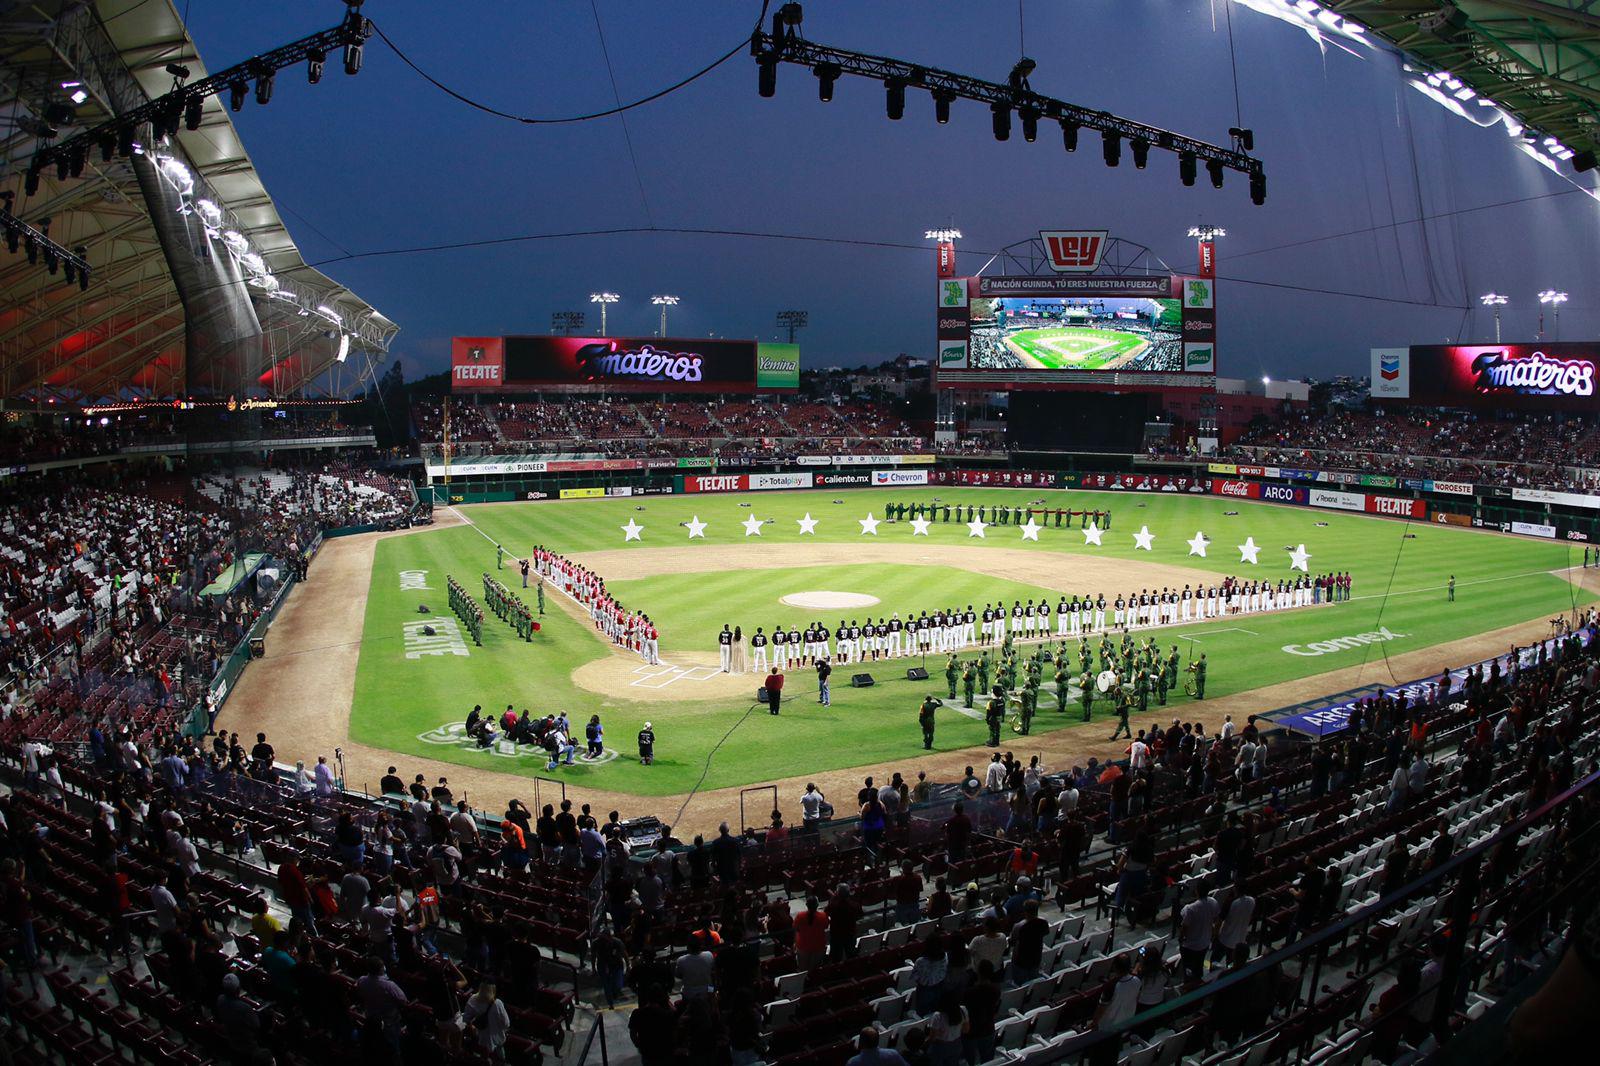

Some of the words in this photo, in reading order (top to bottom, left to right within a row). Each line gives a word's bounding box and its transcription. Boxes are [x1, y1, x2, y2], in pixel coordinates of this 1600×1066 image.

[991, 279, 1021, 289] NACIÓN
[1022, 281, 1055, 289] GUINDA,
[1056, 279, 1067, 288] TÚ
[1126, 281, 1158, 289] FUERZA
[759, 356, 797, 372] Yemina
[453, 365, 500, 380] TECATE
[517, 463, 545, 471] PIONEER
[695, 475, 741, 491] TECATE
[769, 476, 803, 486] Totalplay
[824, 475, 869, 484] caliente.mx
[890, 473, 923, 482] Chevron
[1221, 480, 1249, 496] Coca-Cola
[1264, 486, 1294, 501] ARCO
[1434, 483, 1472, 493] NOROESTE
[1374, 496, 1415, 516] TECATE
[1281, 626, 1406, 657] Comex
